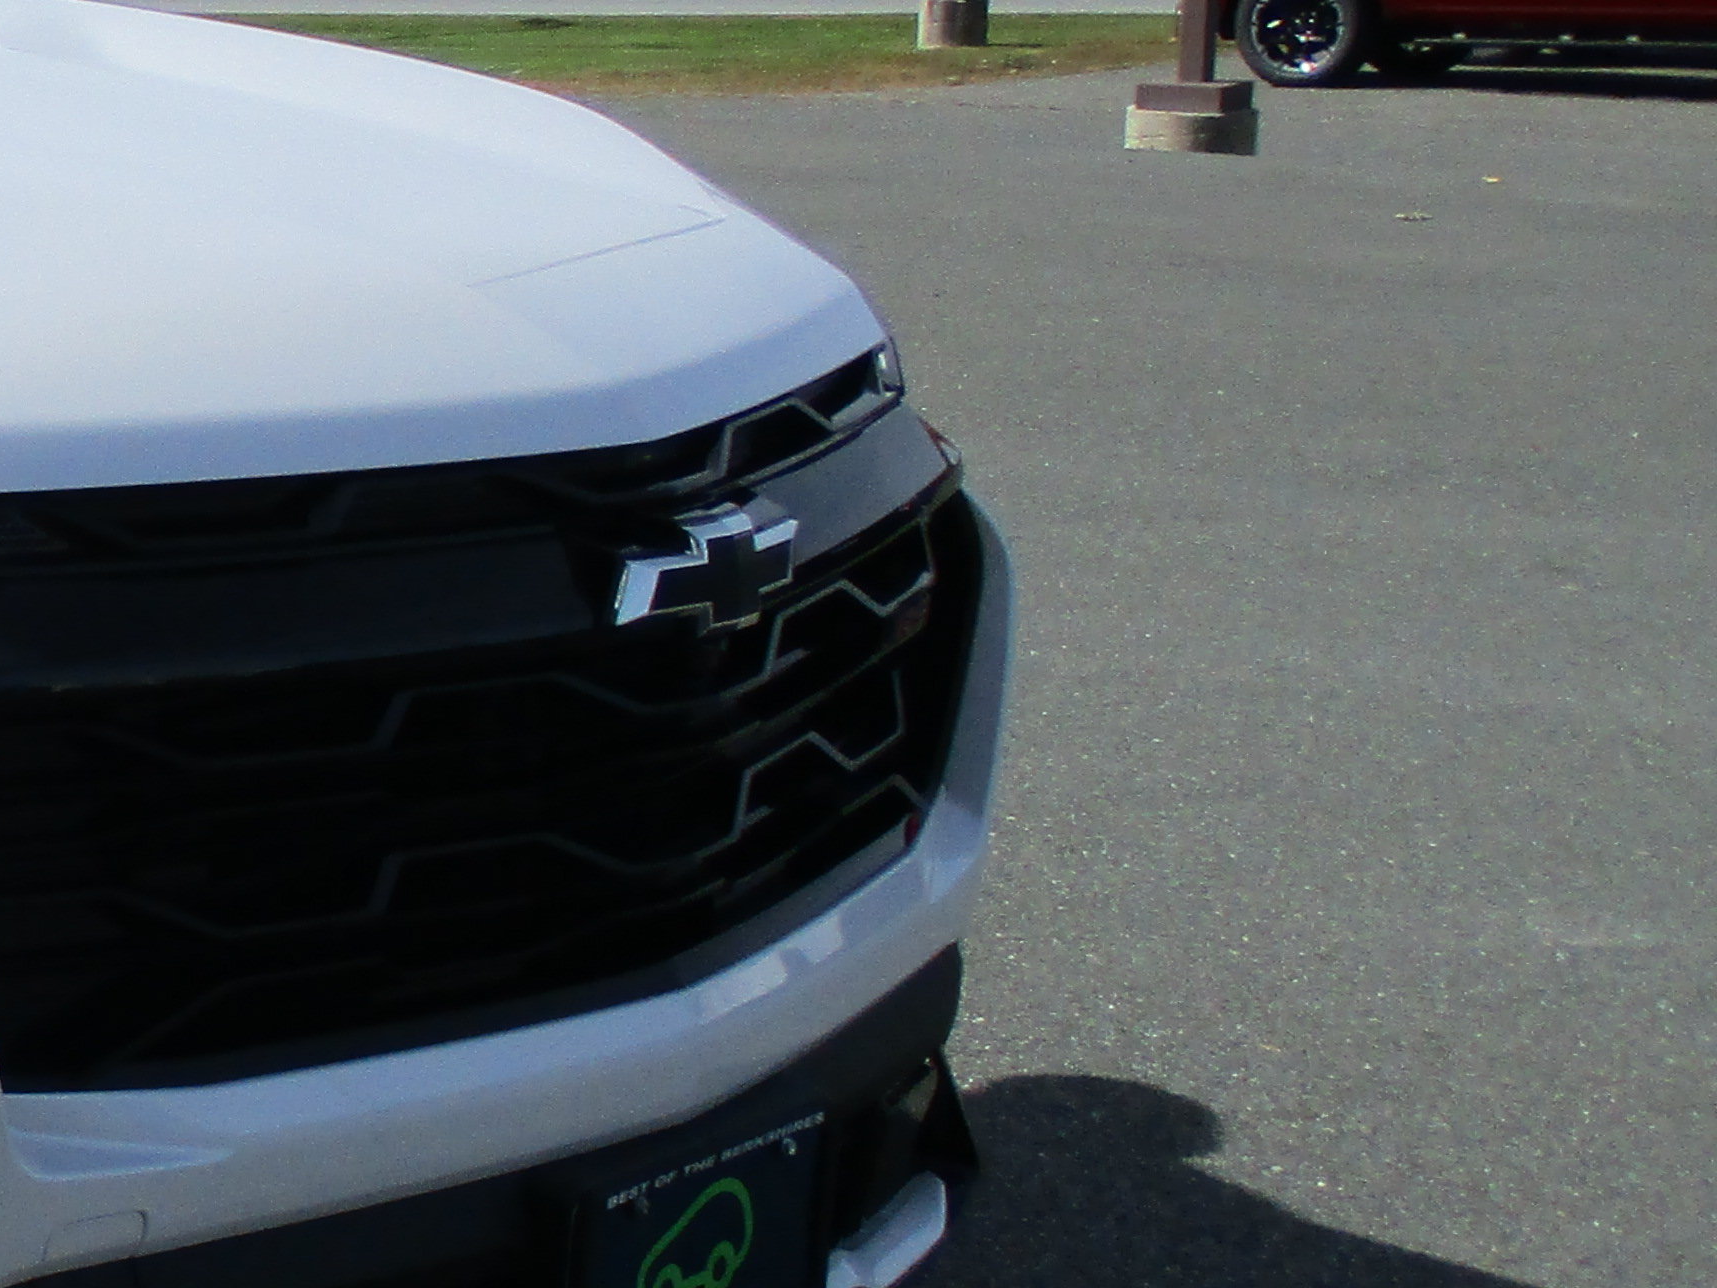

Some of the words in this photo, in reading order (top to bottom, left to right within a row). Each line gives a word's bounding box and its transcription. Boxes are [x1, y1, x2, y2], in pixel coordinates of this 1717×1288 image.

[606, 1181, 651, 1210] BEST
[654, 1169, 678, 1188] OF
[683, 1154, 716, 1177] THE
